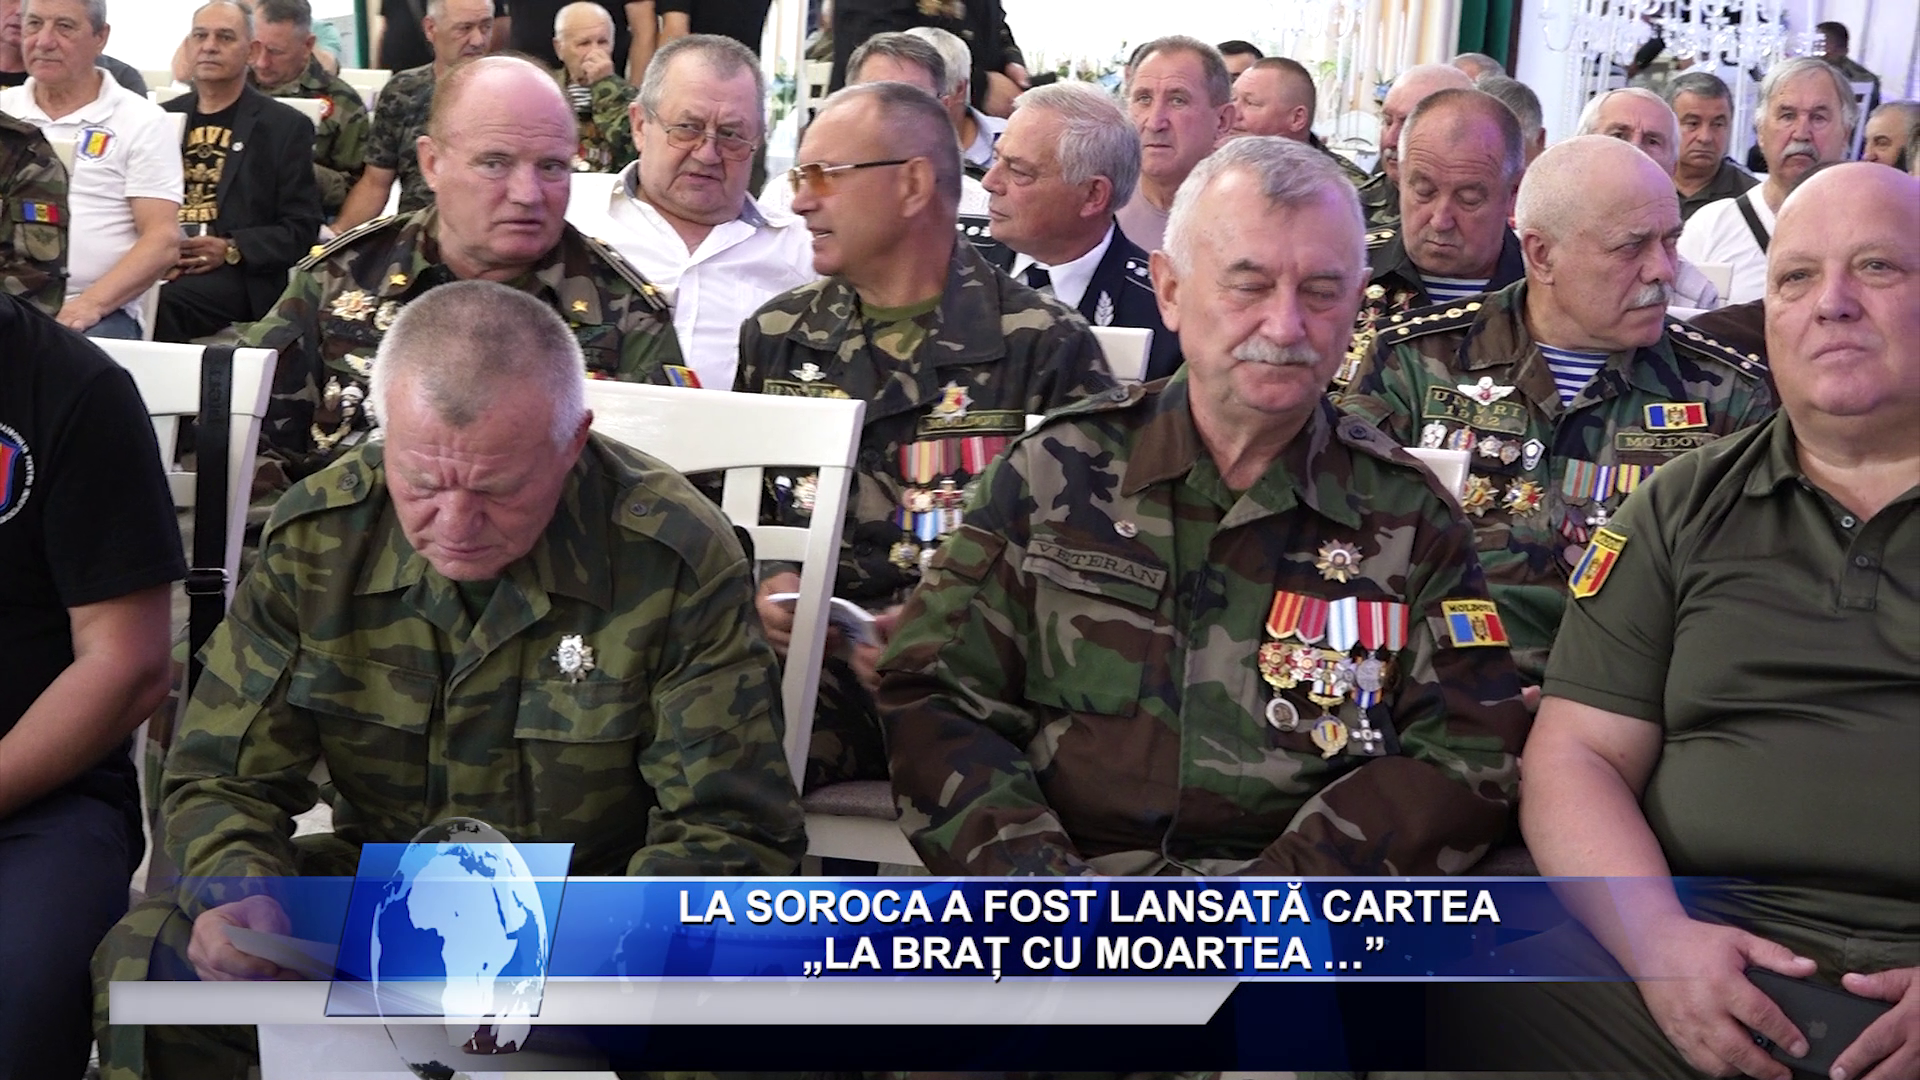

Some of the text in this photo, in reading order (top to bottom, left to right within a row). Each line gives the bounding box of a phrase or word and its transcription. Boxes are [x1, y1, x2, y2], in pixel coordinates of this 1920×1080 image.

[1444, 404, 1500, 427] 1992
[1624, 436, 1706, 448] MOLDOV
[1038, 543, 1160, 584] VETERAN
